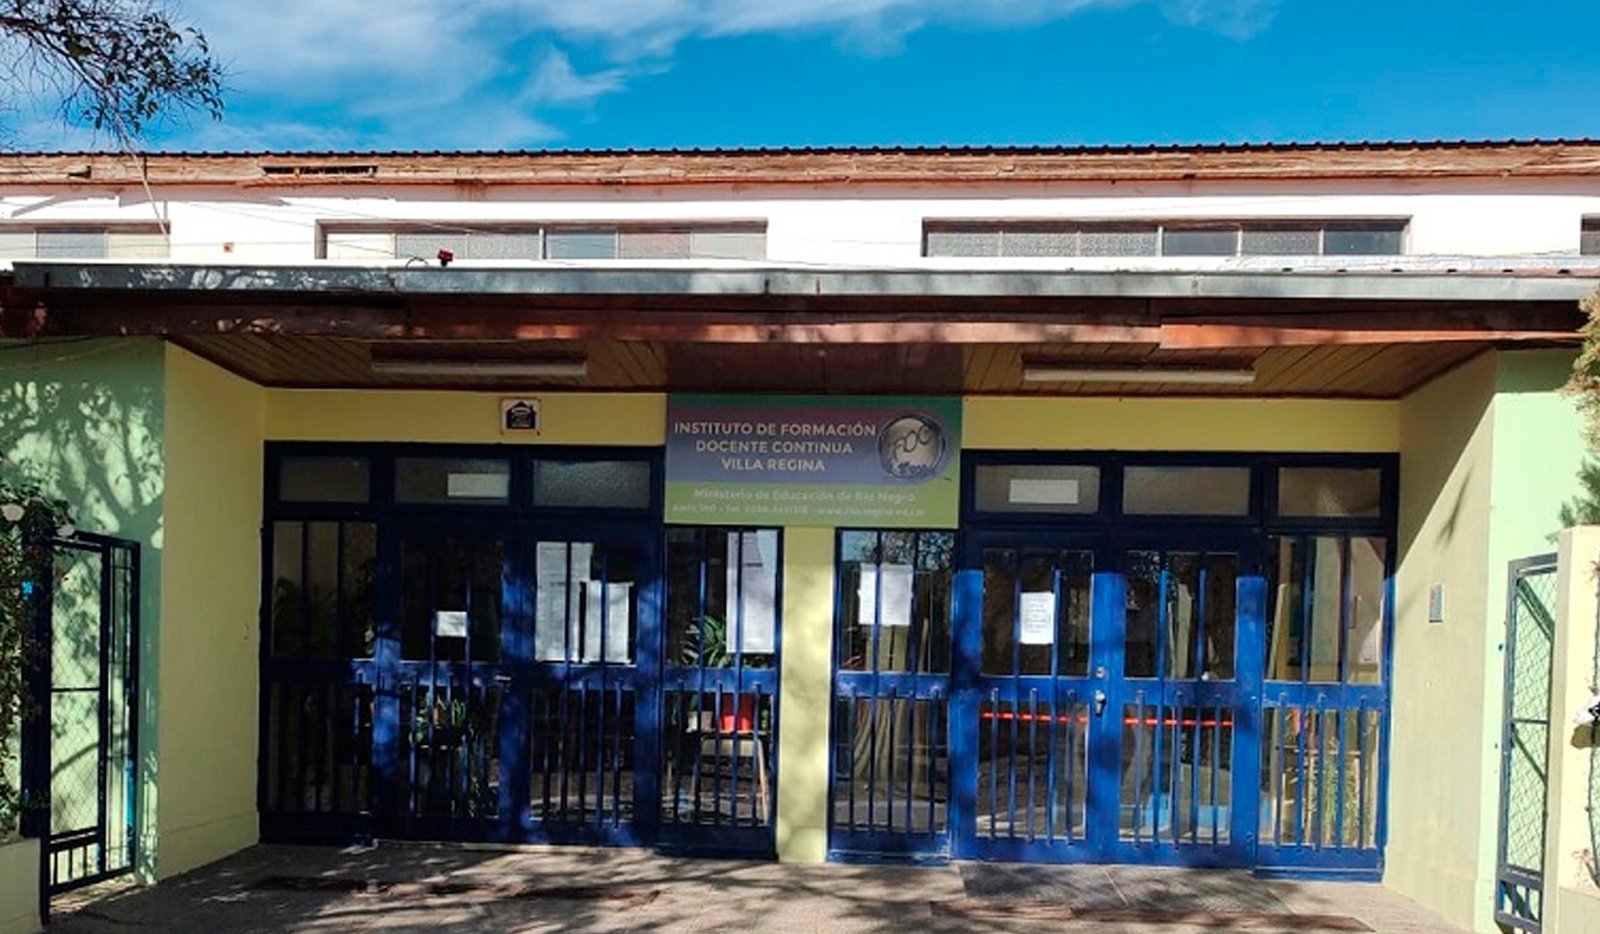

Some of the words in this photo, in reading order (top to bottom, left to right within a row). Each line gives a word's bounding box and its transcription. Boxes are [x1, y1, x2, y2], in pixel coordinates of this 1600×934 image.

[674, 421, 753, 435] INSTITUTO
[757, 422, 777, 436] DE
[780, 420, 877, 437] FORMACIÓN
[695, 440, 768, 454] DOCENTE
[771, 441, 853, 455] CONTINUA
[721, 457, 764, 471] VILLA
[767, 458, 825, 472] REGINA
